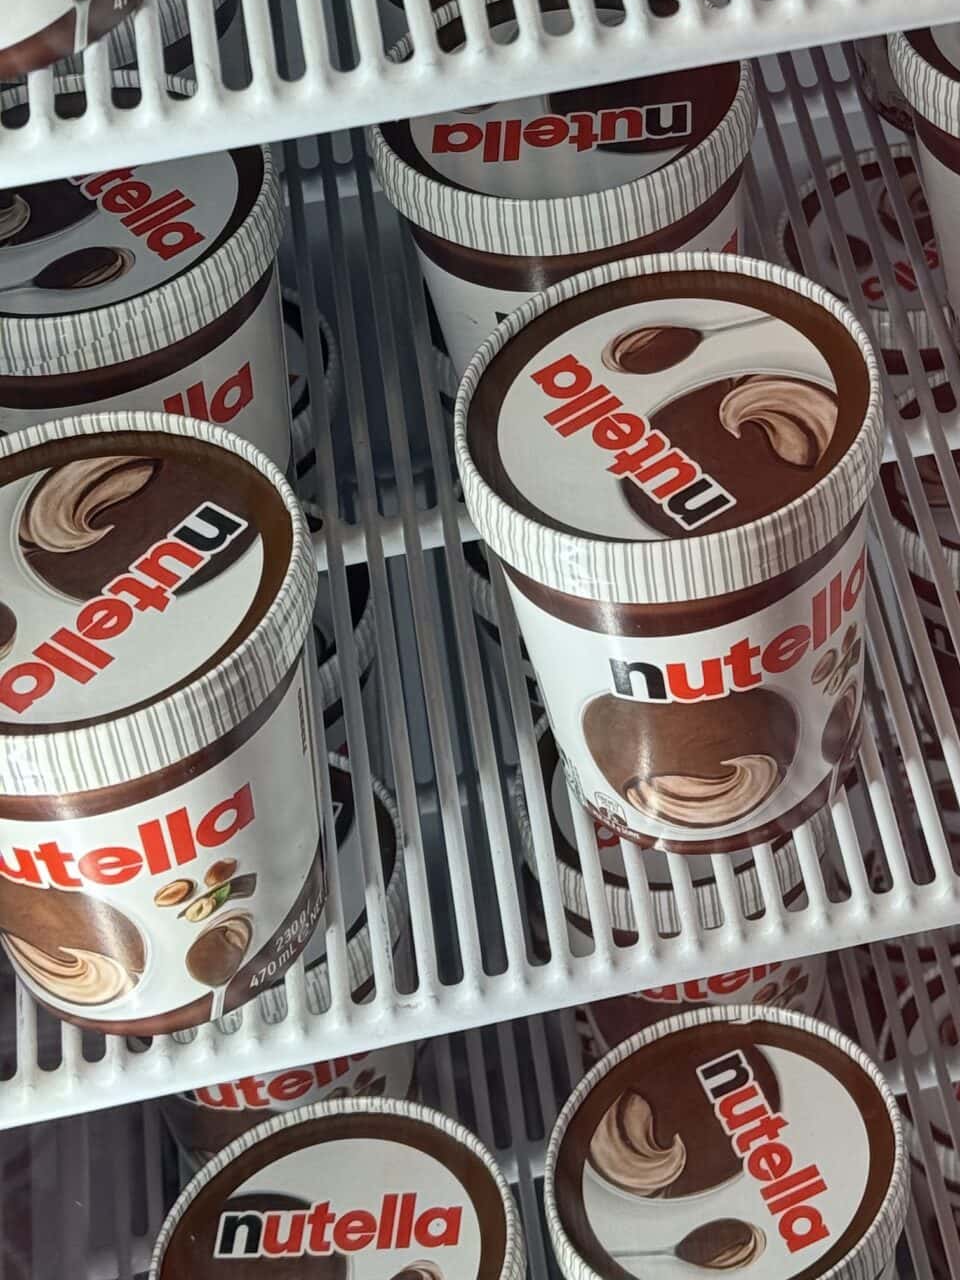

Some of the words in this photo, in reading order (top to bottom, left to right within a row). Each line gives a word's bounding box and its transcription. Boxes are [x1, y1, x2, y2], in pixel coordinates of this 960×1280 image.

[431, 103, 690, 163] nutella
[80, 167, 205, 261] tella
[531, 354, 734, 528] nutella
[1, 504, 245, 714] nutella
[0, 782, 256, 887] utella
[250, 961, 277, 988] 470
[698, 1051, 830, 1254] nutella
[218, 1192, 463, 1255] nutella
